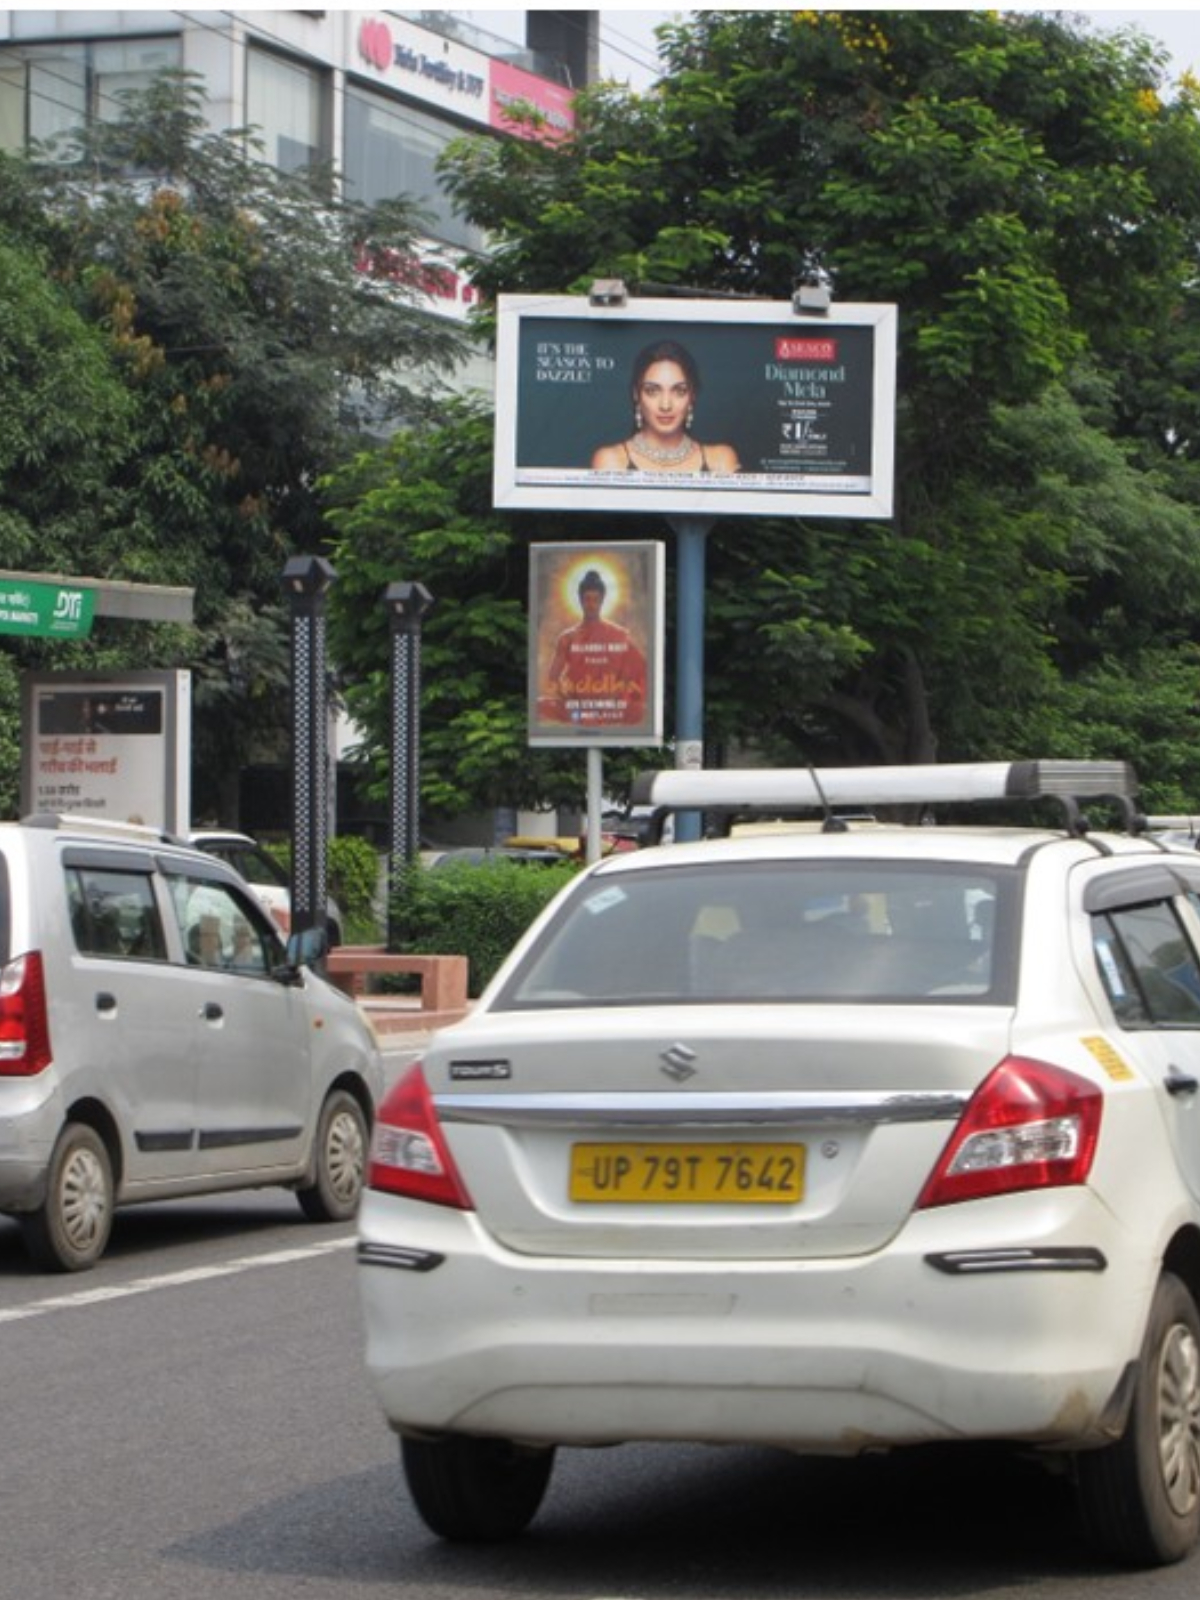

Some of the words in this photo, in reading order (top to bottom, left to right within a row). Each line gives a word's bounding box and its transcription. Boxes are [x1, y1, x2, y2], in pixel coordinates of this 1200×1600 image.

[564, 343, 588, 355] THE
[537, 357, 591, 369] SEASON
[596, 358, 615, 370] TO
[536, 370, 591, 382] DAZZLE!
[764, 364, 845, 381] Diamond
[784, 381, 827, 399] Mela
[593, 1157, 631, 1191] UP
[642, 1156, 703, 1191] 79T
[714, 1156, 796, 1192] 7642
